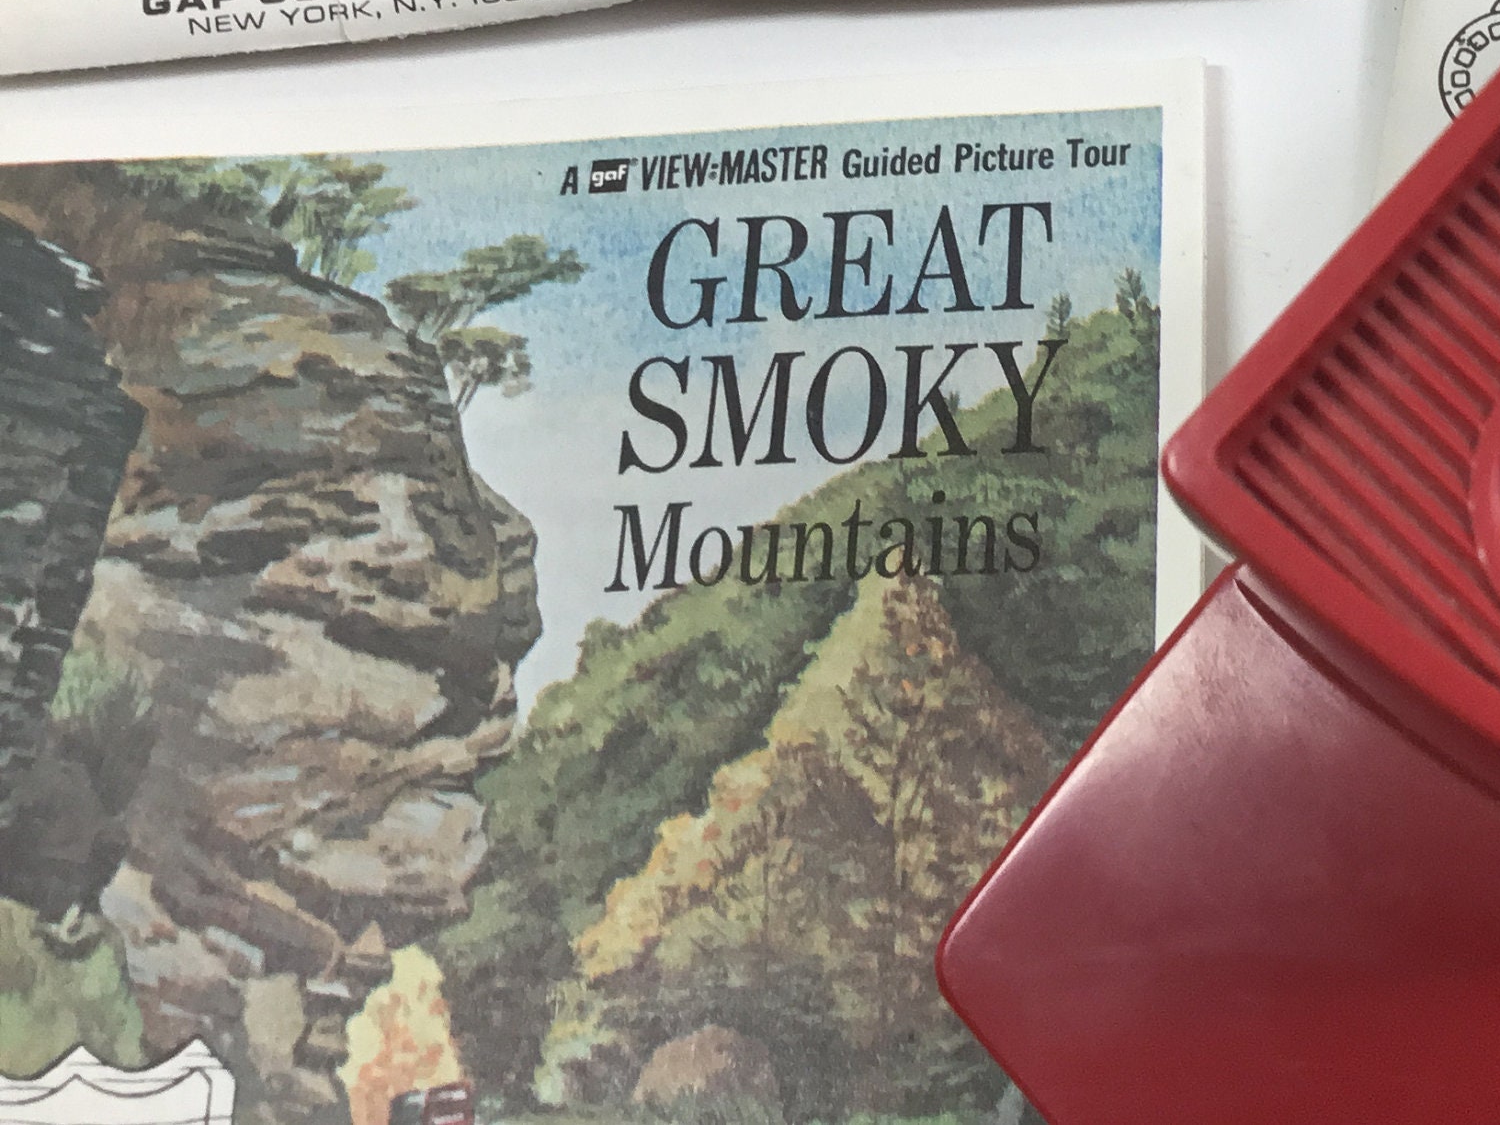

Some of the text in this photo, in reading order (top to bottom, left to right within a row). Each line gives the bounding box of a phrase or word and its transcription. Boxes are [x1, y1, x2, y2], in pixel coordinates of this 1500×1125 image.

[188, 11, 265, 35] NEW
[280, 0, 381, 26] YORK,
[561, 167, 579, 196] A
[842, 144, 942, 179] Guided
[954, 143, 1054, 173] Picture
[1066, 138, 1131, 168] Tour
[646, 201, 1055, 330] GREAT
[618, 340, 1069, 475] SMOKY
[604, 490, 1041, 593] Mountains
